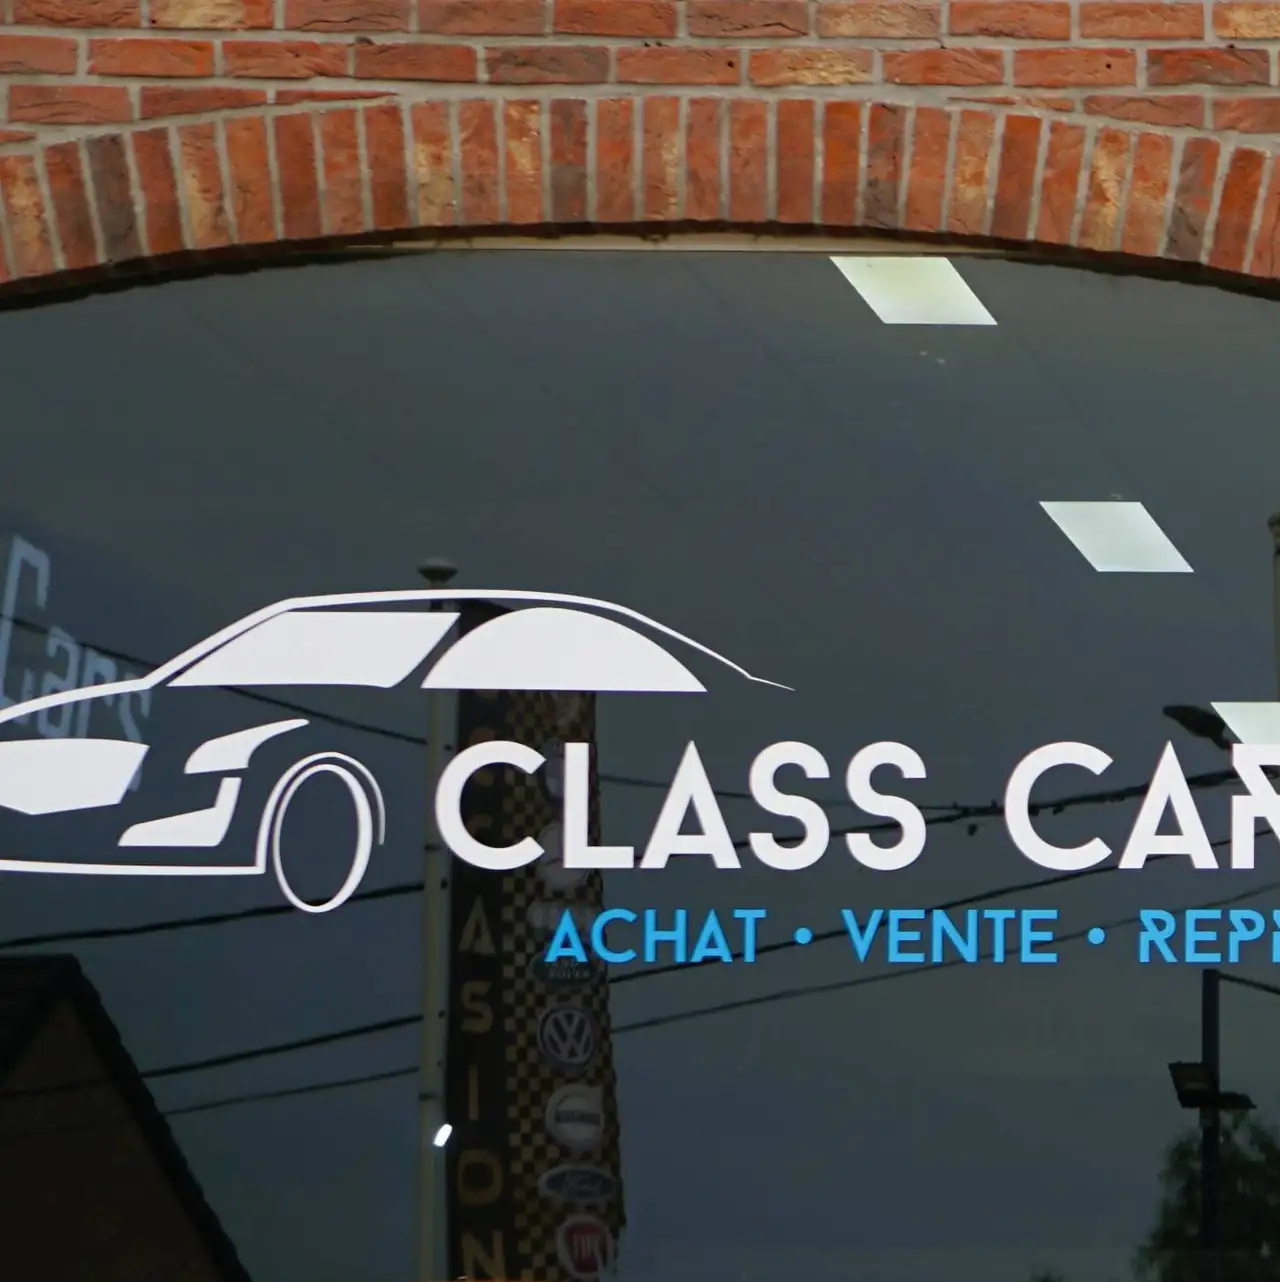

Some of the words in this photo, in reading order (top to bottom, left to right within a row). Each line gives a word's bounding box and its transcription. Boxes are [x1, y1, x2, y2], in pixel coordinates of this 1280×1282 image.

[435, 741, 928, 871] CLASS
[544, 909, 767, 963] ACHAT
[841, 909, 1058, 963] VENTE
